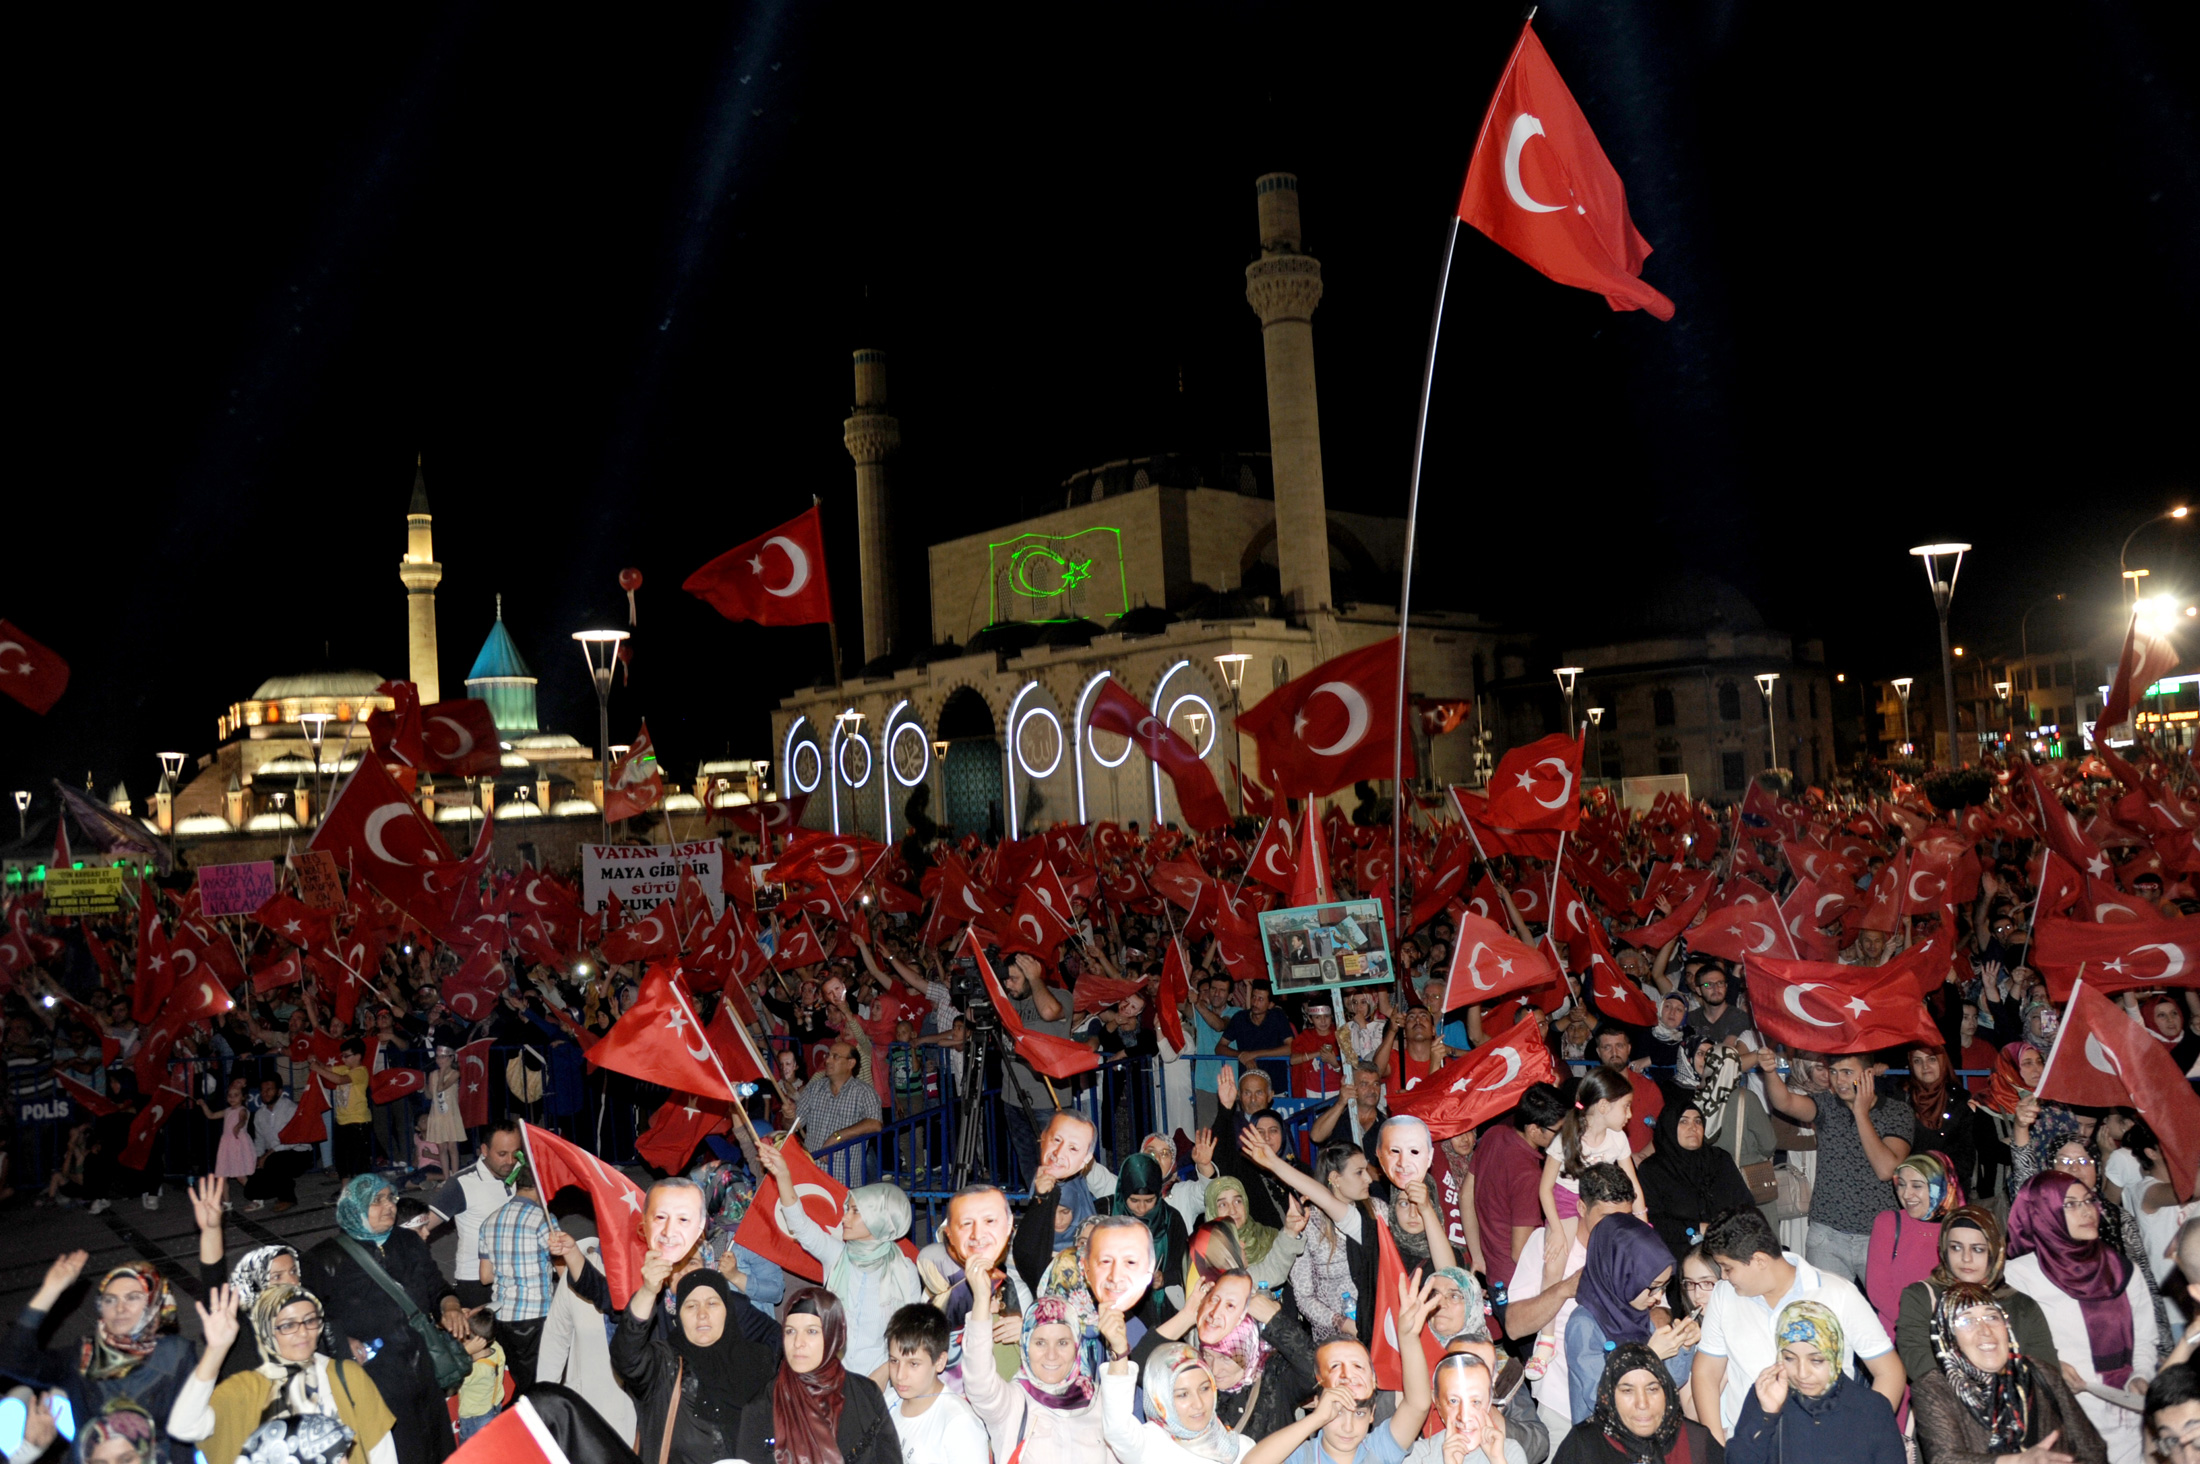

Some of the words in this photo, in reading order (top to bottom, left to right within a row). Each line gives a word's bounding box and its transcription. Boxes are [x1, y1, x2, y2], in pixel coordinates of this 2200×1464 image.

[593, 846, 659, 860] VATAN
[670, 841, 715, 859] AŞKI
[601, 867, 645, 879] MAYA
[631, 881, 676, 895] SÜTÜ
[22, 1100, 69, 1121] POLİS
